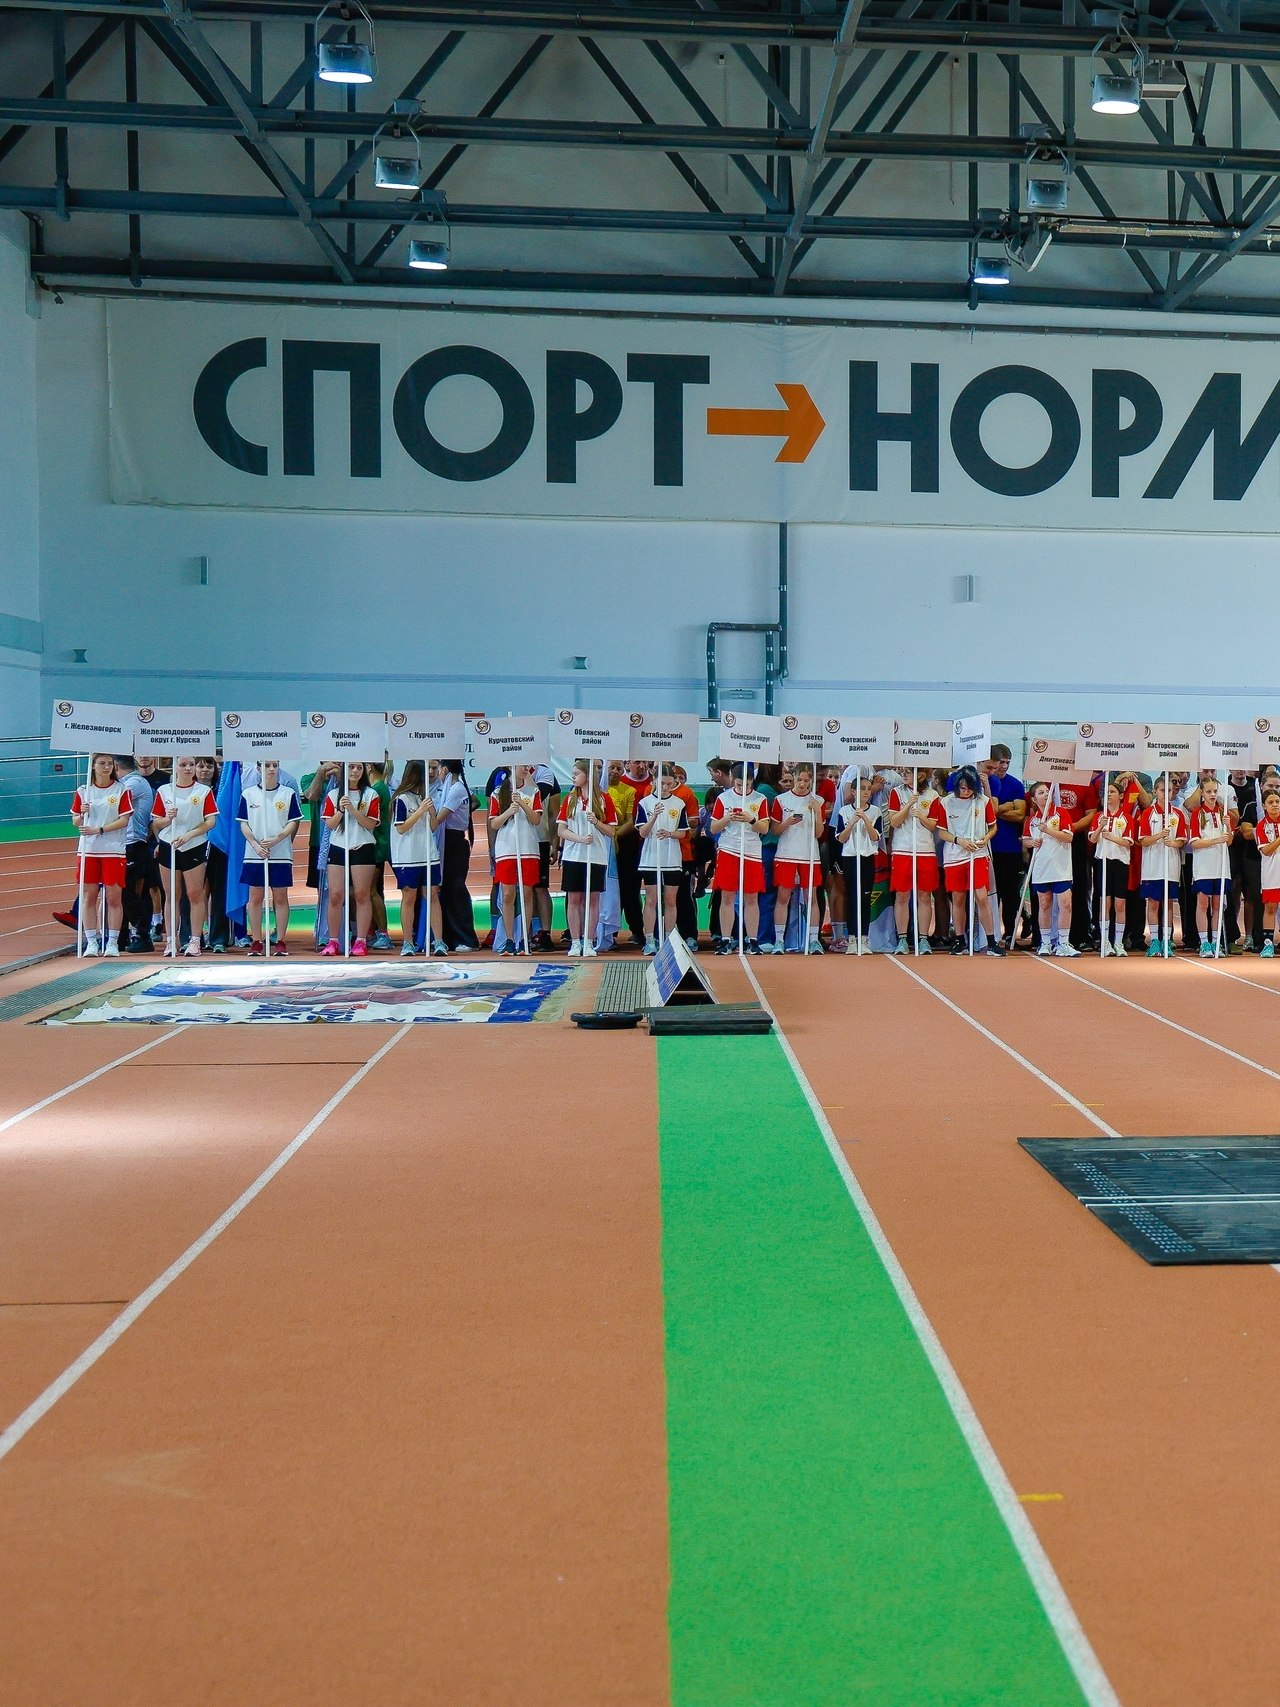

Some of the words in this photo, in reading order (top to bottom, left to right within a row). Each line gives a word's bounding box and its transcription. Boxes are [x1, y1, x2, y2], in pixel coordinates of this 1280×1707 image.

[193, 337, 710, 487] СПОРТ
[70, 723, 122, 733] Железногорск
[140, 728, 210, 736] Железнодорожный
[236, 730, 288, 739] Золотухинский
[332, 732, 360, 740] Курский
[640, 731, 683, 740] Октябрьский
[252, 739, 272, 747] район
[488, 735, 534, 744] Курчатовский
[582, 736, 602, 745] район
[651, 739, 672, 747] район
[840, 736, 876, 744] Фатежский
[335, 740, 356, 748] район
[502, 744, 522, 752] район
[848, 744, 868, 752] район
[1086, 741, 1135, 749] Железногорский
[1147, 742, 1190, 750] Касторенский
